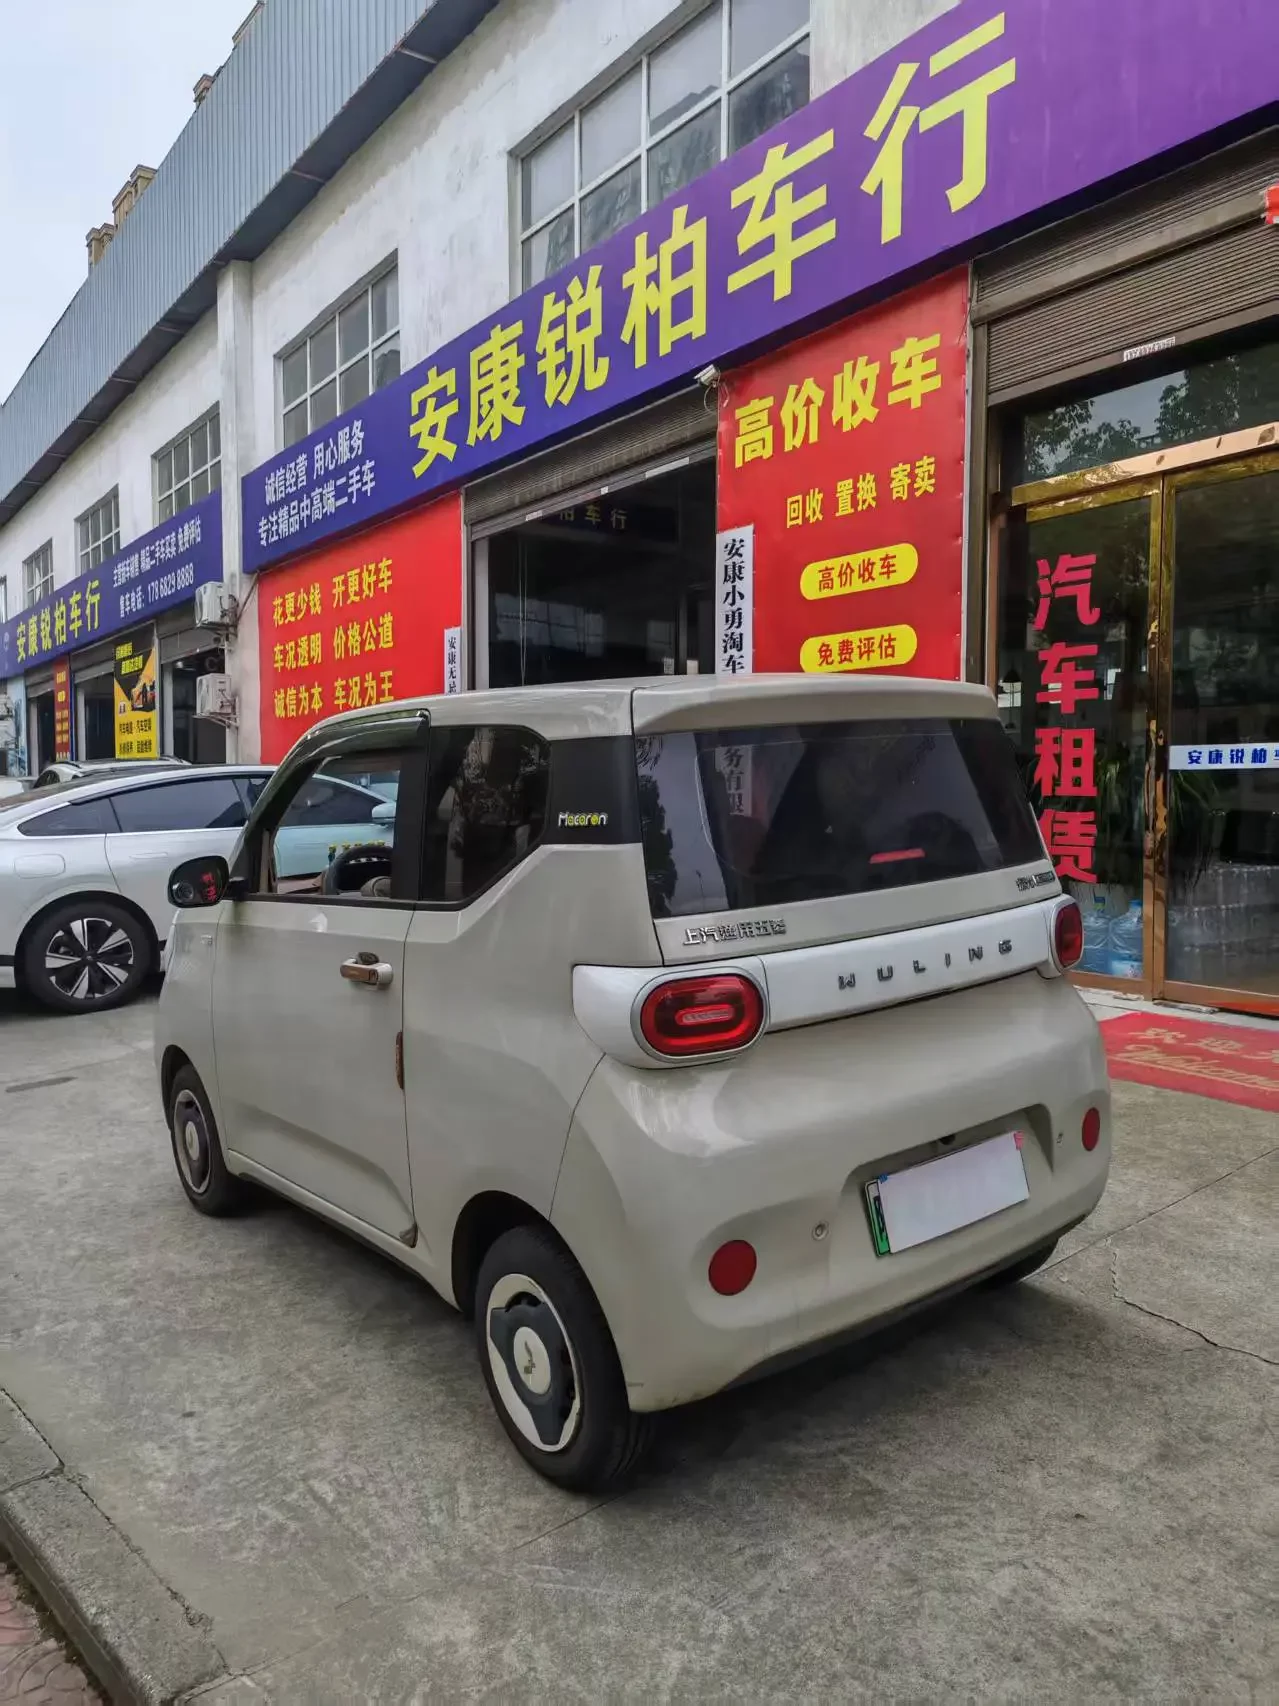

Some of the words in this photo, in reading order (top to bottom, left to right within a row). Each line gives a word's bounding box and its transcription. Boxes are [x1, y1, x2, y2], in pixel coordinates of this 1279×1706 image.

[409, 12, 1017, 479] 安康锐柏车行
[734, 333, 942, 469] 高价收车
[265, 453, 308, 505] 诚信经营
[314, 420, 365, 480] 用心服务
[786, 488, 824, 529] 回收
[835, 472, 877, 517] 置换
[889, 455, 936, 501] 寄卖
[259, 460, 376, 547] 专注精品中高端二手车
[272, 583, 322, 628] 花更少钱
[332, 558, 393, 609] 开更好车
[722, 538, 745, 674] 安康小勇淘车
[818, 554, 897, 592] 高价收车
[16, 579, 101, 664] 安康锐柏车行
[273, 632, 322, 673] 车况透明
[333, 613, 394, 660] 价格公道
[818, 633, 897, 667] 免费评估
[274, 682, 324, 719] 诚信为本
[334, 671, 394, 711] 车况为王
[1034, 553, 1101, 885] 汽车租赁
[558, 812, 608, 827] Macaron
[838, 939, 1013, 990] WULING
